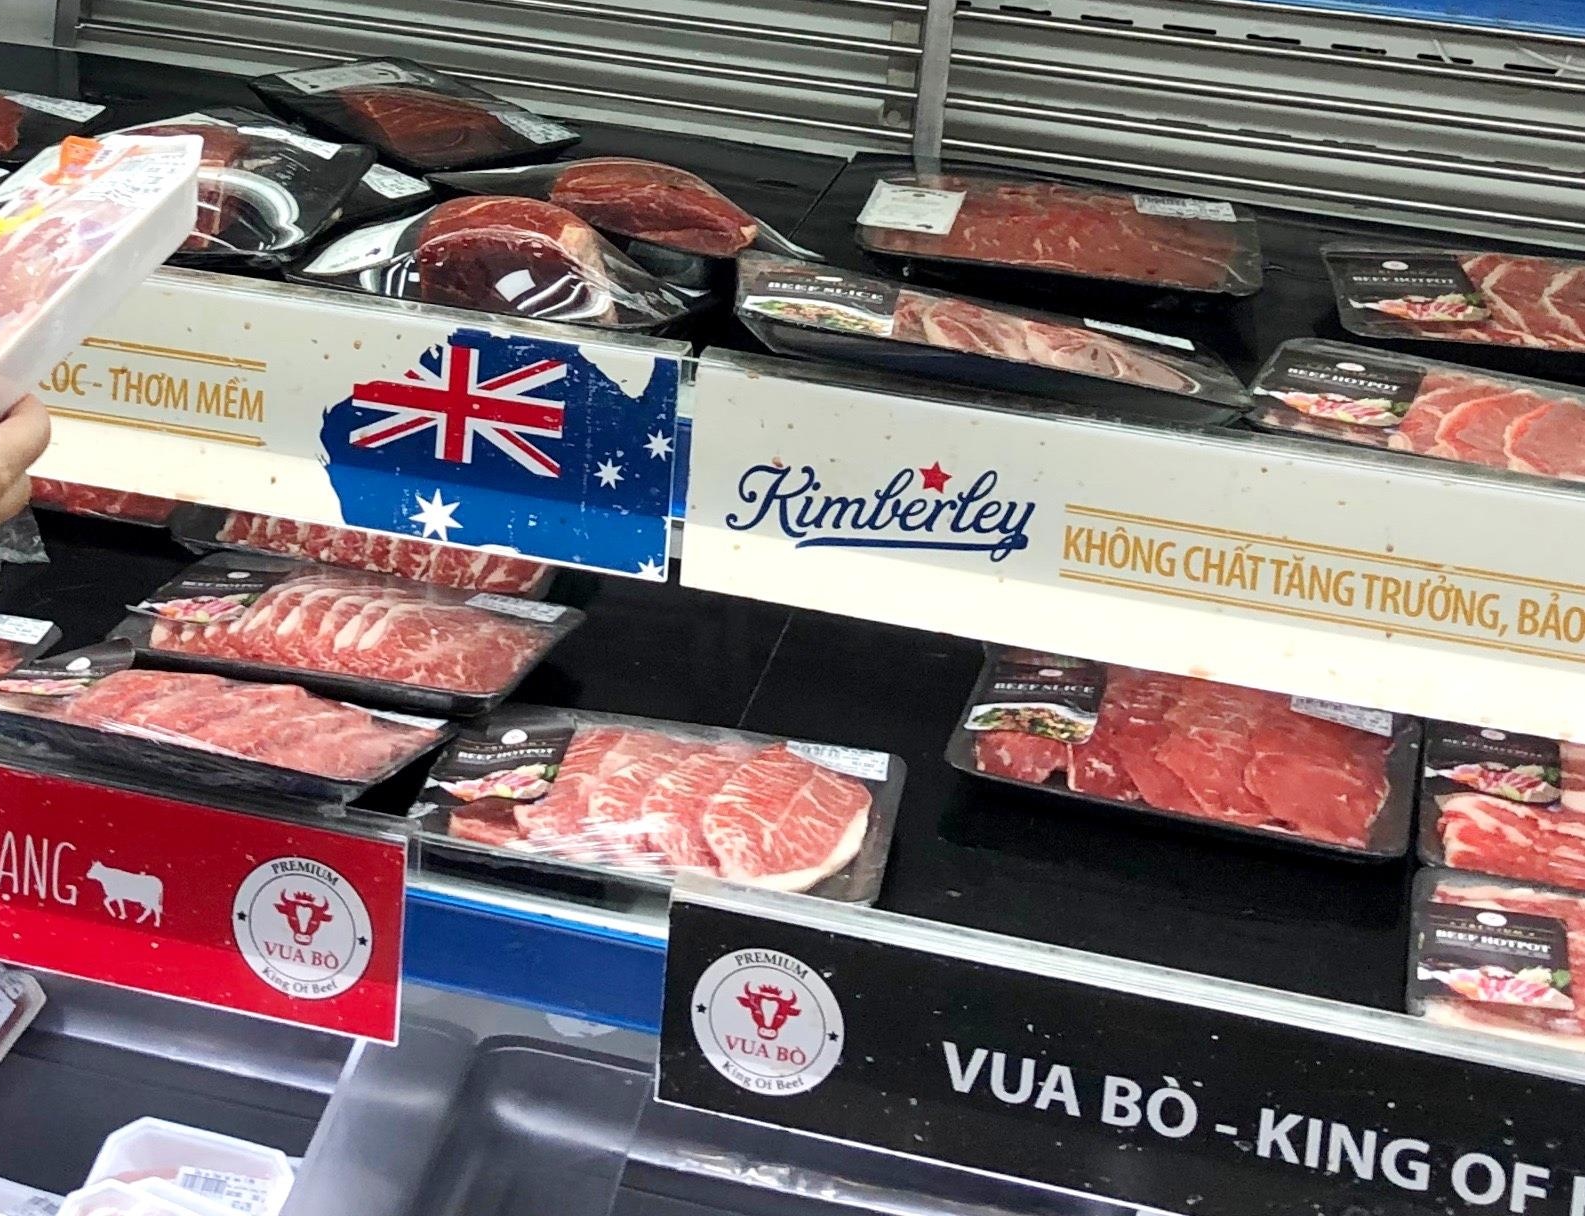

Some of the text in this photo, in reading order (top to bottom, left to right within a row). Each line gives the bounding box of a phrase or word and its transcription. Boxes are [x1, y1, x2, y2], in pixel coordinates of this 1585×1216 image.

[108, 367, 190, 411] THƠM
[195, 375, 265, 423] MỀM
[725, 464, 1036, 562] Kimberley
[1063, 525, 1585, 643] KHÔNG CHẤT TĂNG TRƯỞNG, BẢO
[271, 859, 339, 886] PREMIUM
[264, 941, 340, 970] VUA BÒ
[734, 951, 809, 981] PREMIUM
[262, 966, 339, 994] King Of Beef
[725, 1034, 807, 1067] VUA BÒ
[722, 1060, 805, 1091] King Of Beef
[941, 1040, 1081, 1117] VUA
[1101, 1074, 1199, 1139] BÒ
[1256, 1107, 1431, 1192] KING
[1451, 1152, 1552, 1214] OF
